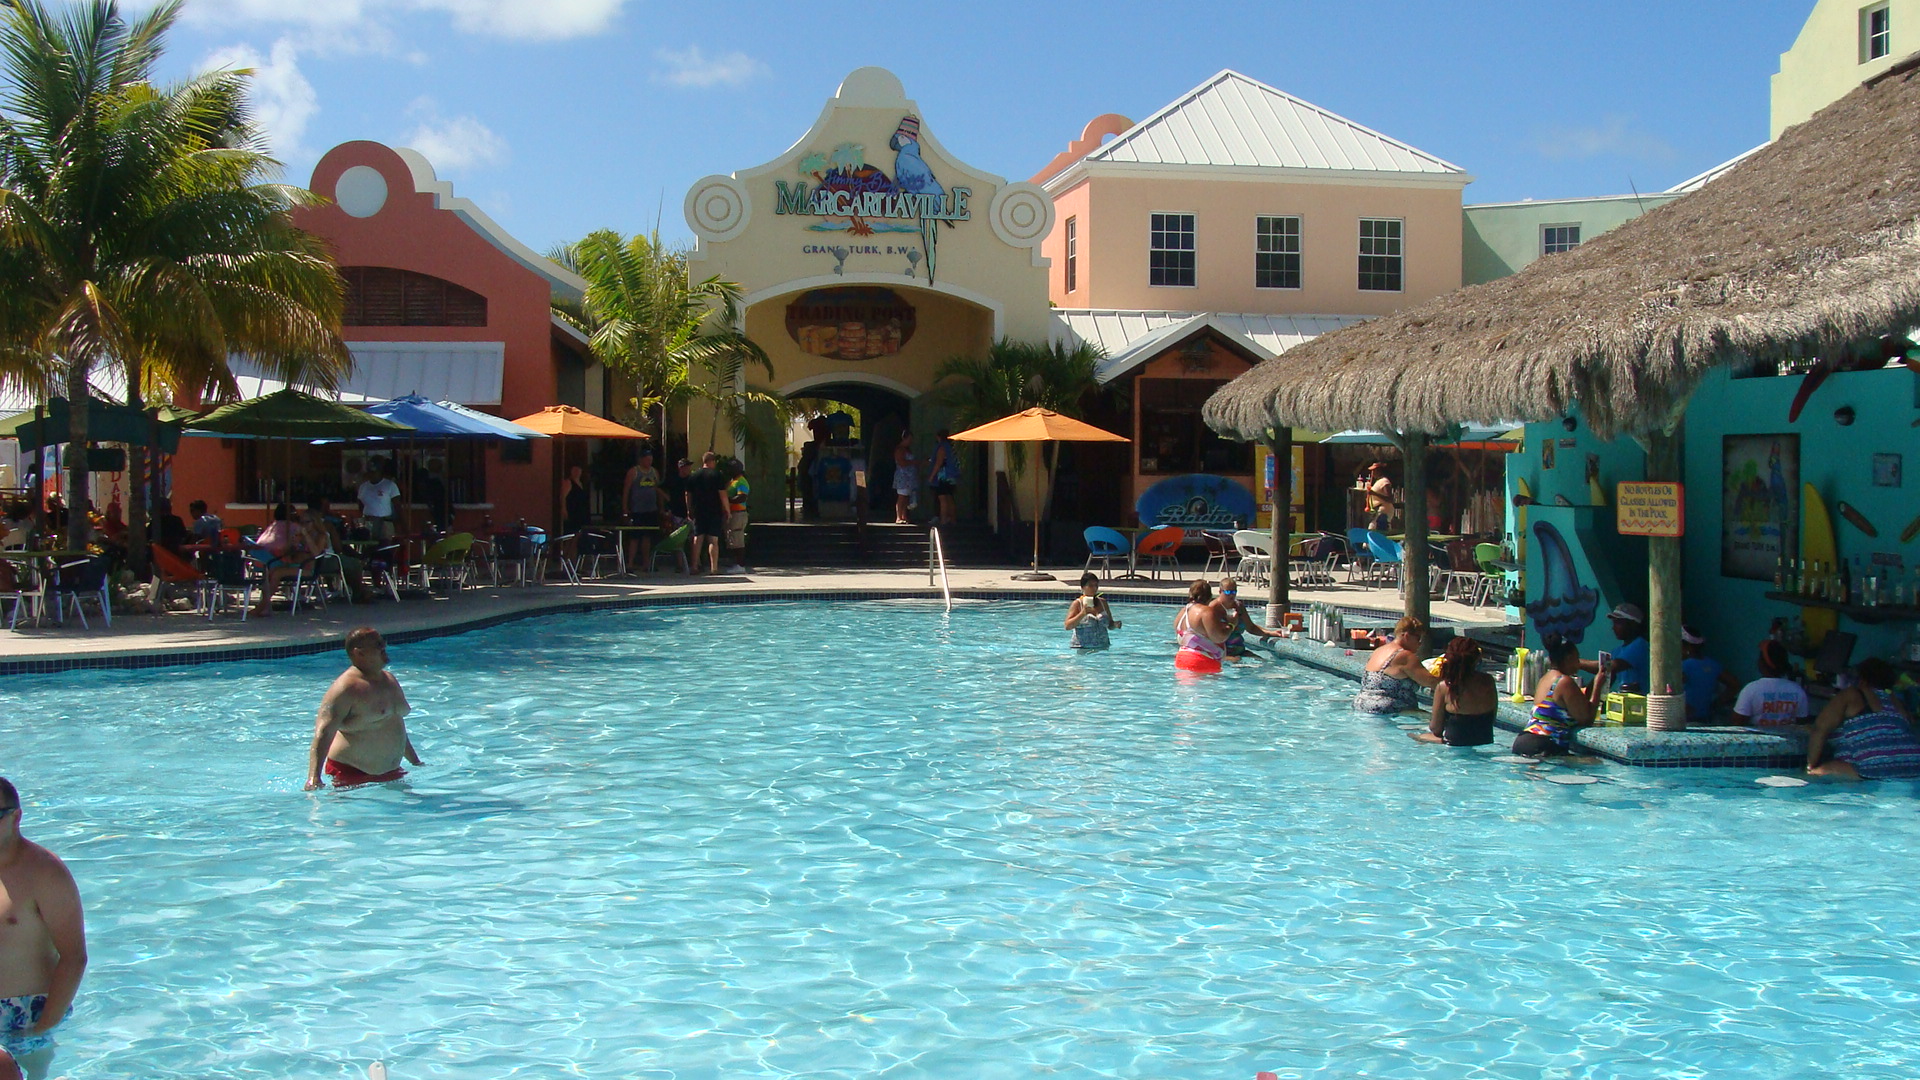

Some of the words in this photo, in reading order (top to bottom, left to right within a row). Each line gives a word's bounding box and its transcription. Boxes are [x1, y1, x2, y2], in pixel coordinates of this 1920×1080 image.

[775, 180, 972, 221] MARGARITAVILLE
[802, 244, 846, 254] GRAN
[849, 245, 882, 255] TURK,
[1762, 701, 1798, 714] PARTY
